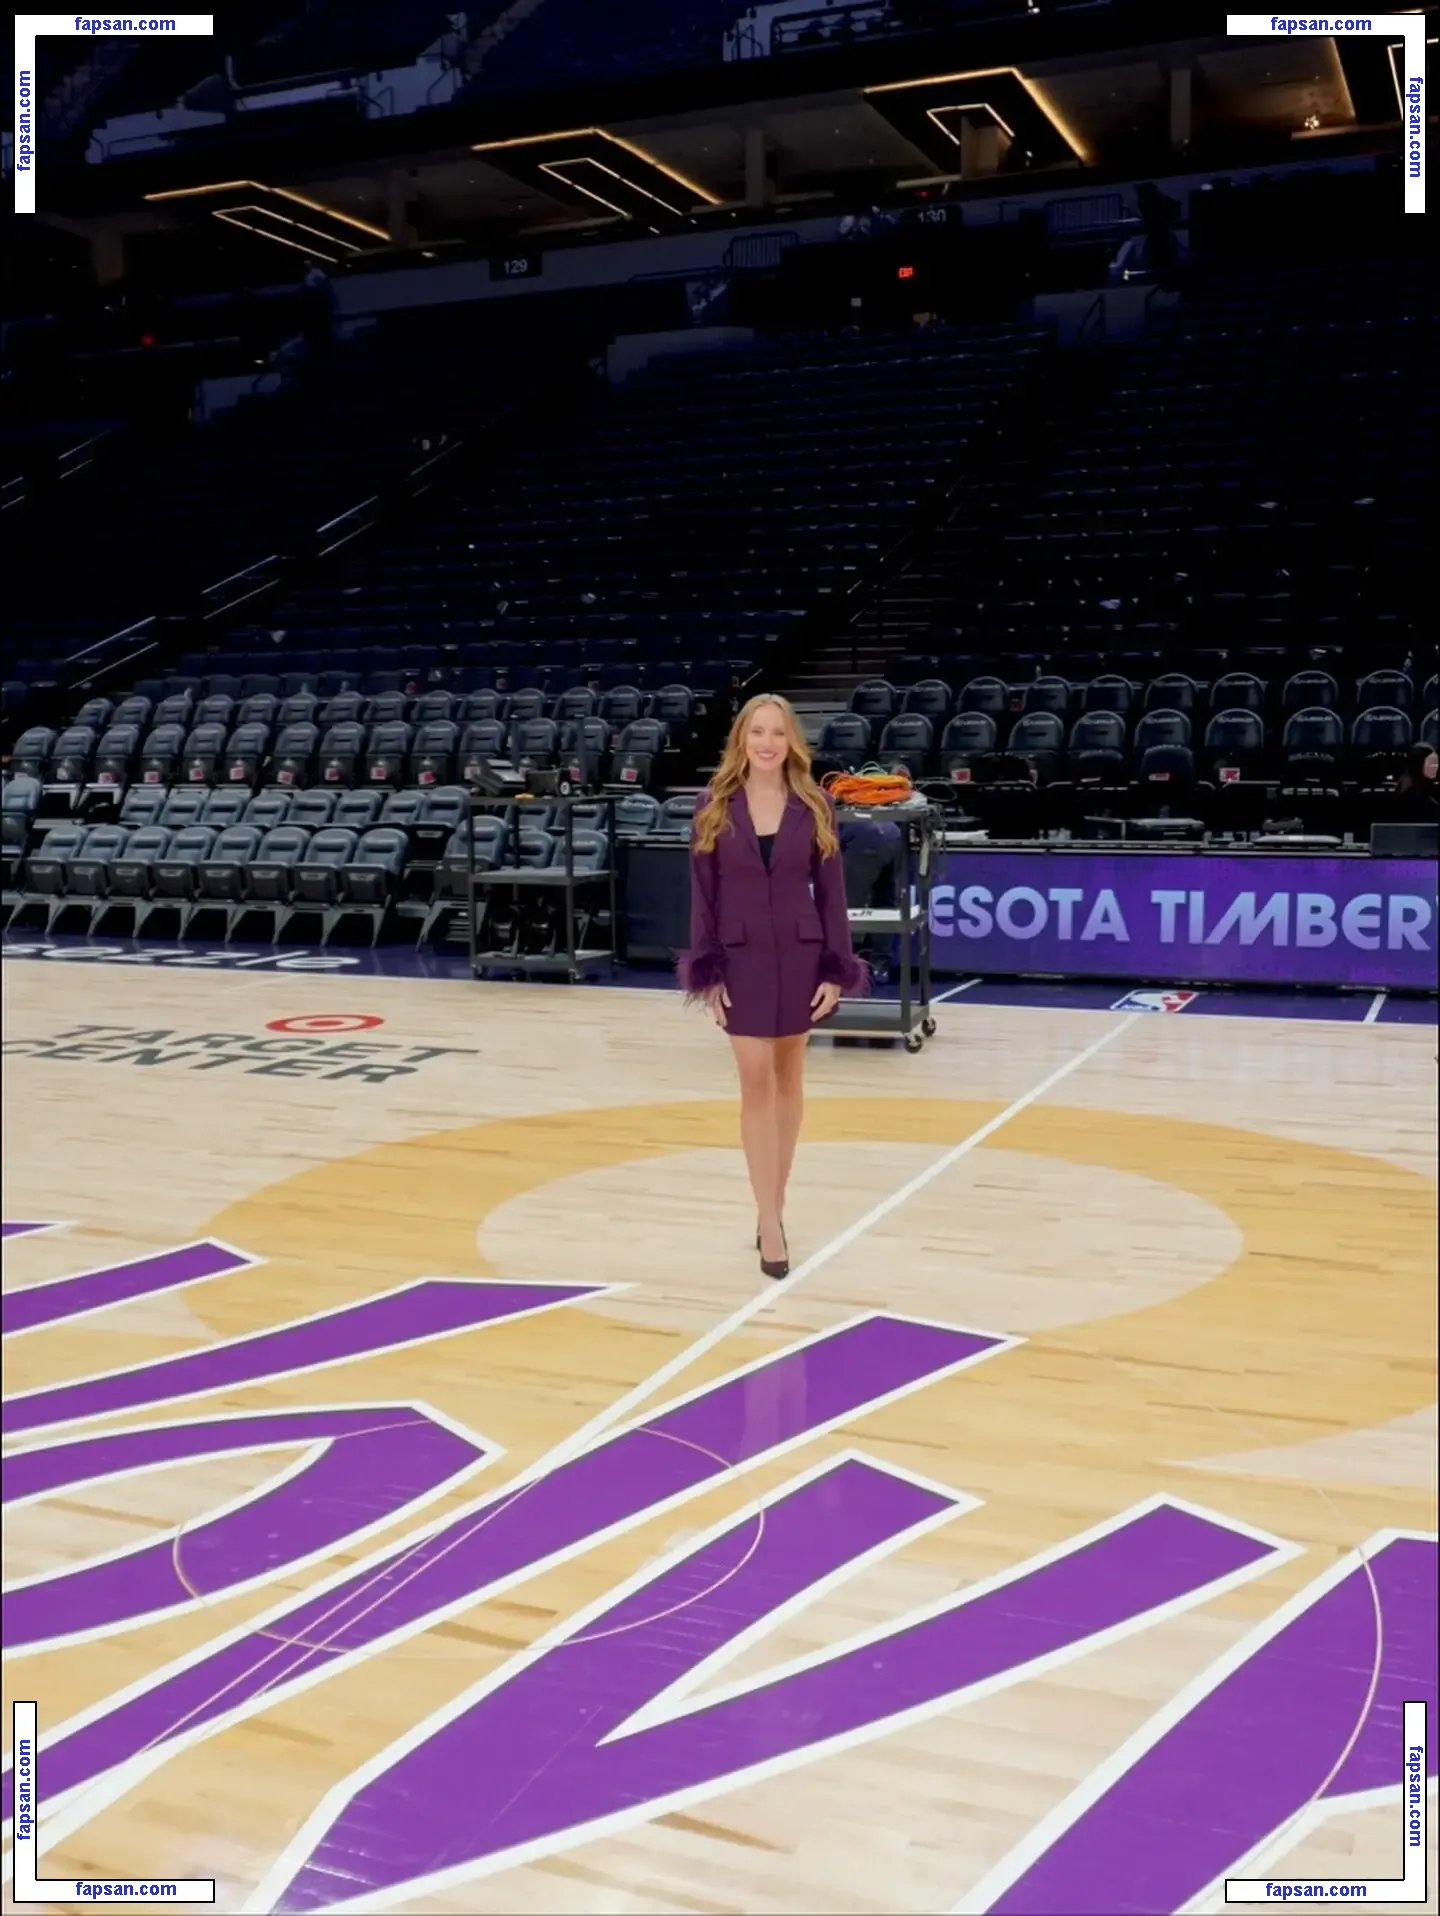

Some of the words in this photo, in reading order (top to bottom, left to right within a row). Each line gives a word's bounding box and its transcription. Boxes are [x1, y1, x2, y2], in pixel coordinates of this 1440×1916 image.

[503, 258, 529, 274] 129
[910, 884, 1130, 943] ESOTA
[1150, 889, 1439, 952] TIMBER
[2, 1039, 418, 1083] CENTER
[53, 1024, 481, 1063] TARGET
